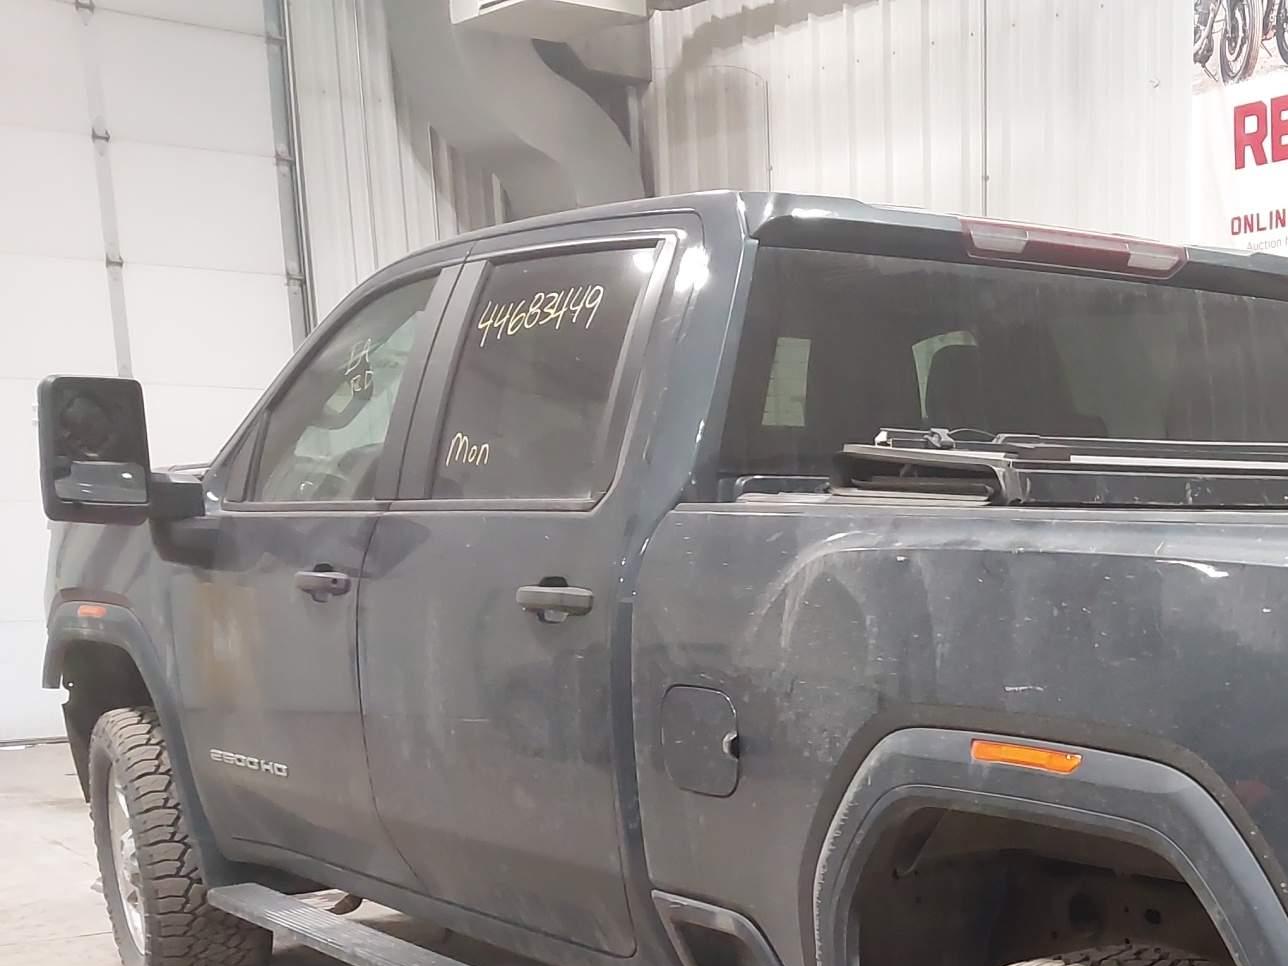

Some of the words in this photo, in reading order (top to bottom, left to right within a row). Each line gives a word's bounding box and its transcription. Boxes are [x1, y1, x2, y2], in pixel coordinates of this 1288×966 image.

[1246, 238, 1282, 251] Auction
[478, 284, 604, 347] 44683449
[446, 432, 490, 467] Mon
